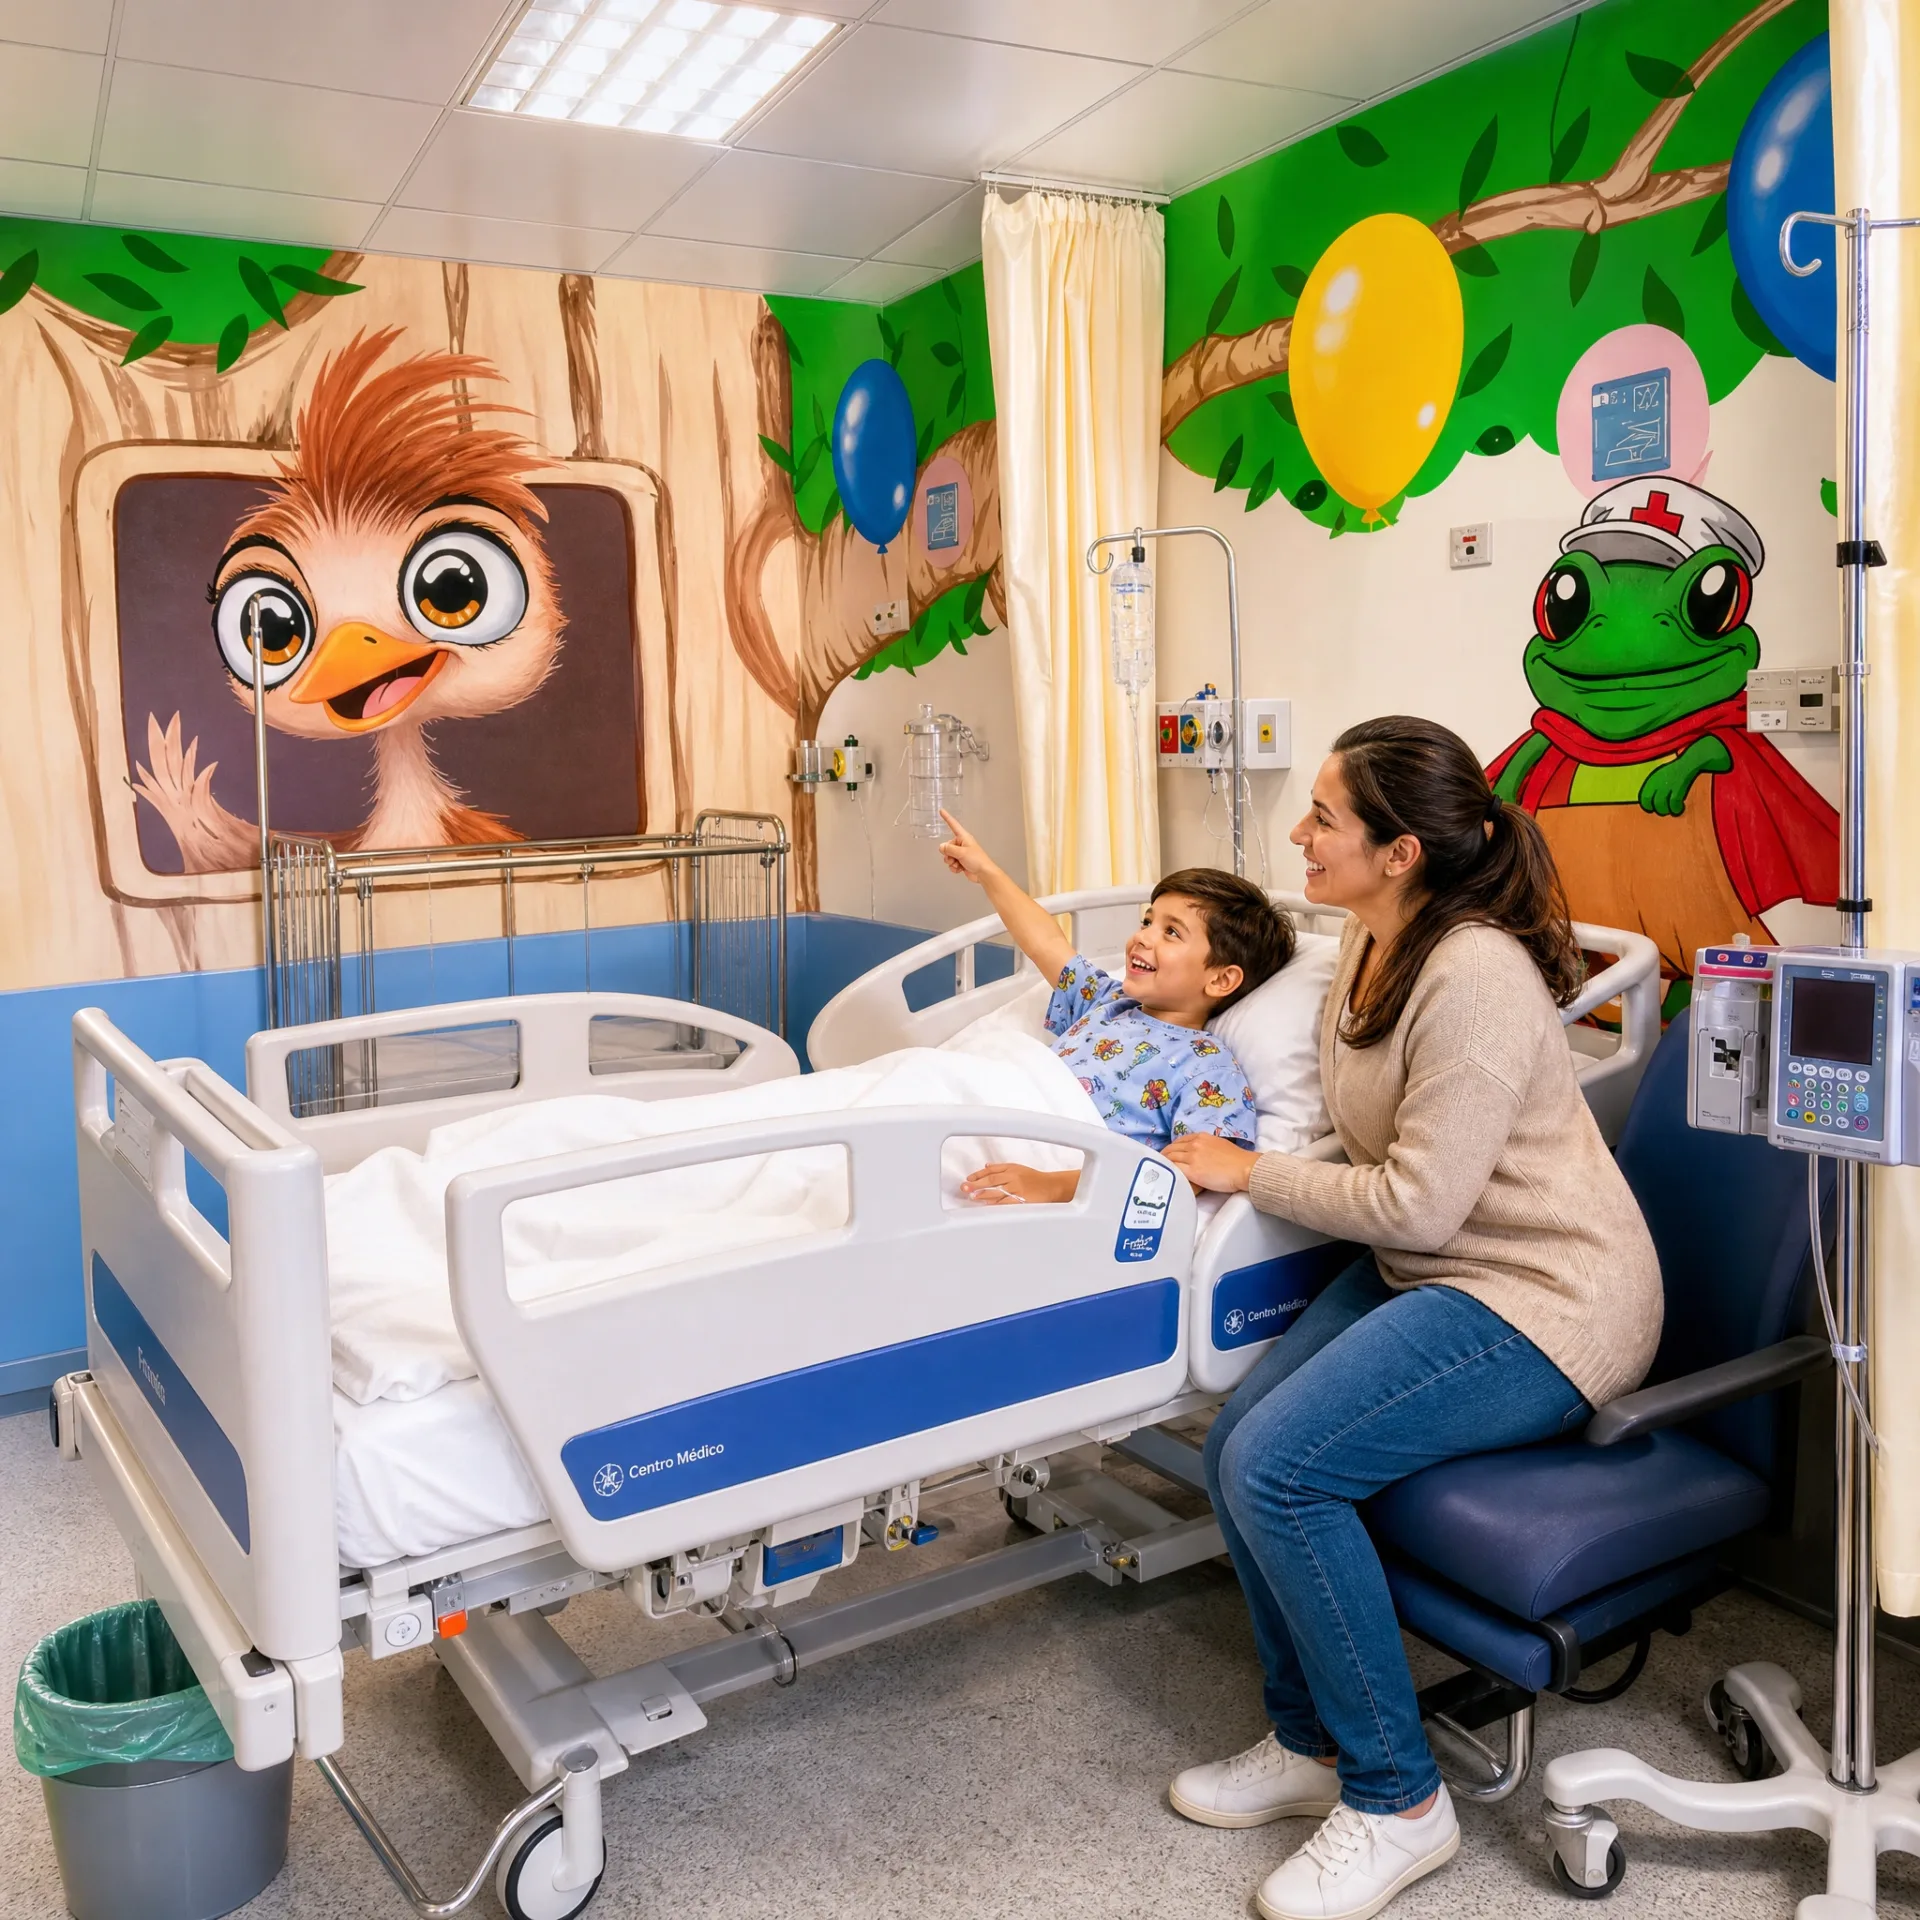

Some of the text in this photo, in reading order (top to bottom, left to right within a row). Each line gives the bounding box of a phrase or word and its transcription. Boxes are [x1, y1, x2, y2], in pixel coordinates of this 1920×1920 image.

[1248, 1299, 1308, 1322] Centro Médico
[629, 1444, 724, 1478] Centro Médico
